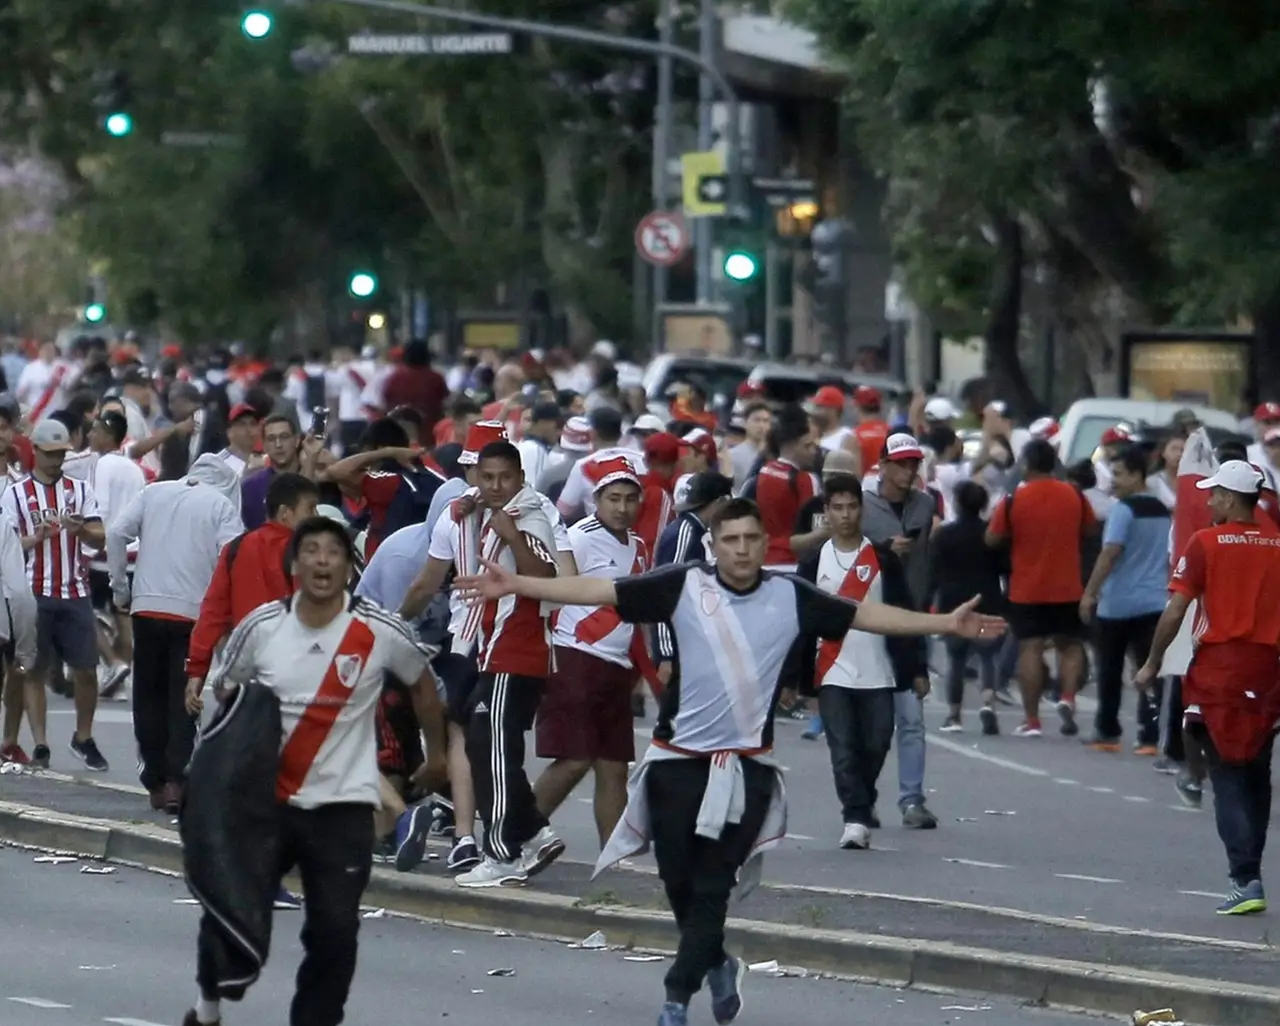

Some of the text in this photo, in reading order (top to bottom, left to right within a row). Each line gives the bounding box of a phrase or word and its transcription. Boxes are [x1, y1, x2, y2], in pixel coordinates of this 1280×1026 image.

[349, 33, 510, 53] MANUEL UGARTE
[1217, 533, 1247, 545] BBVA
